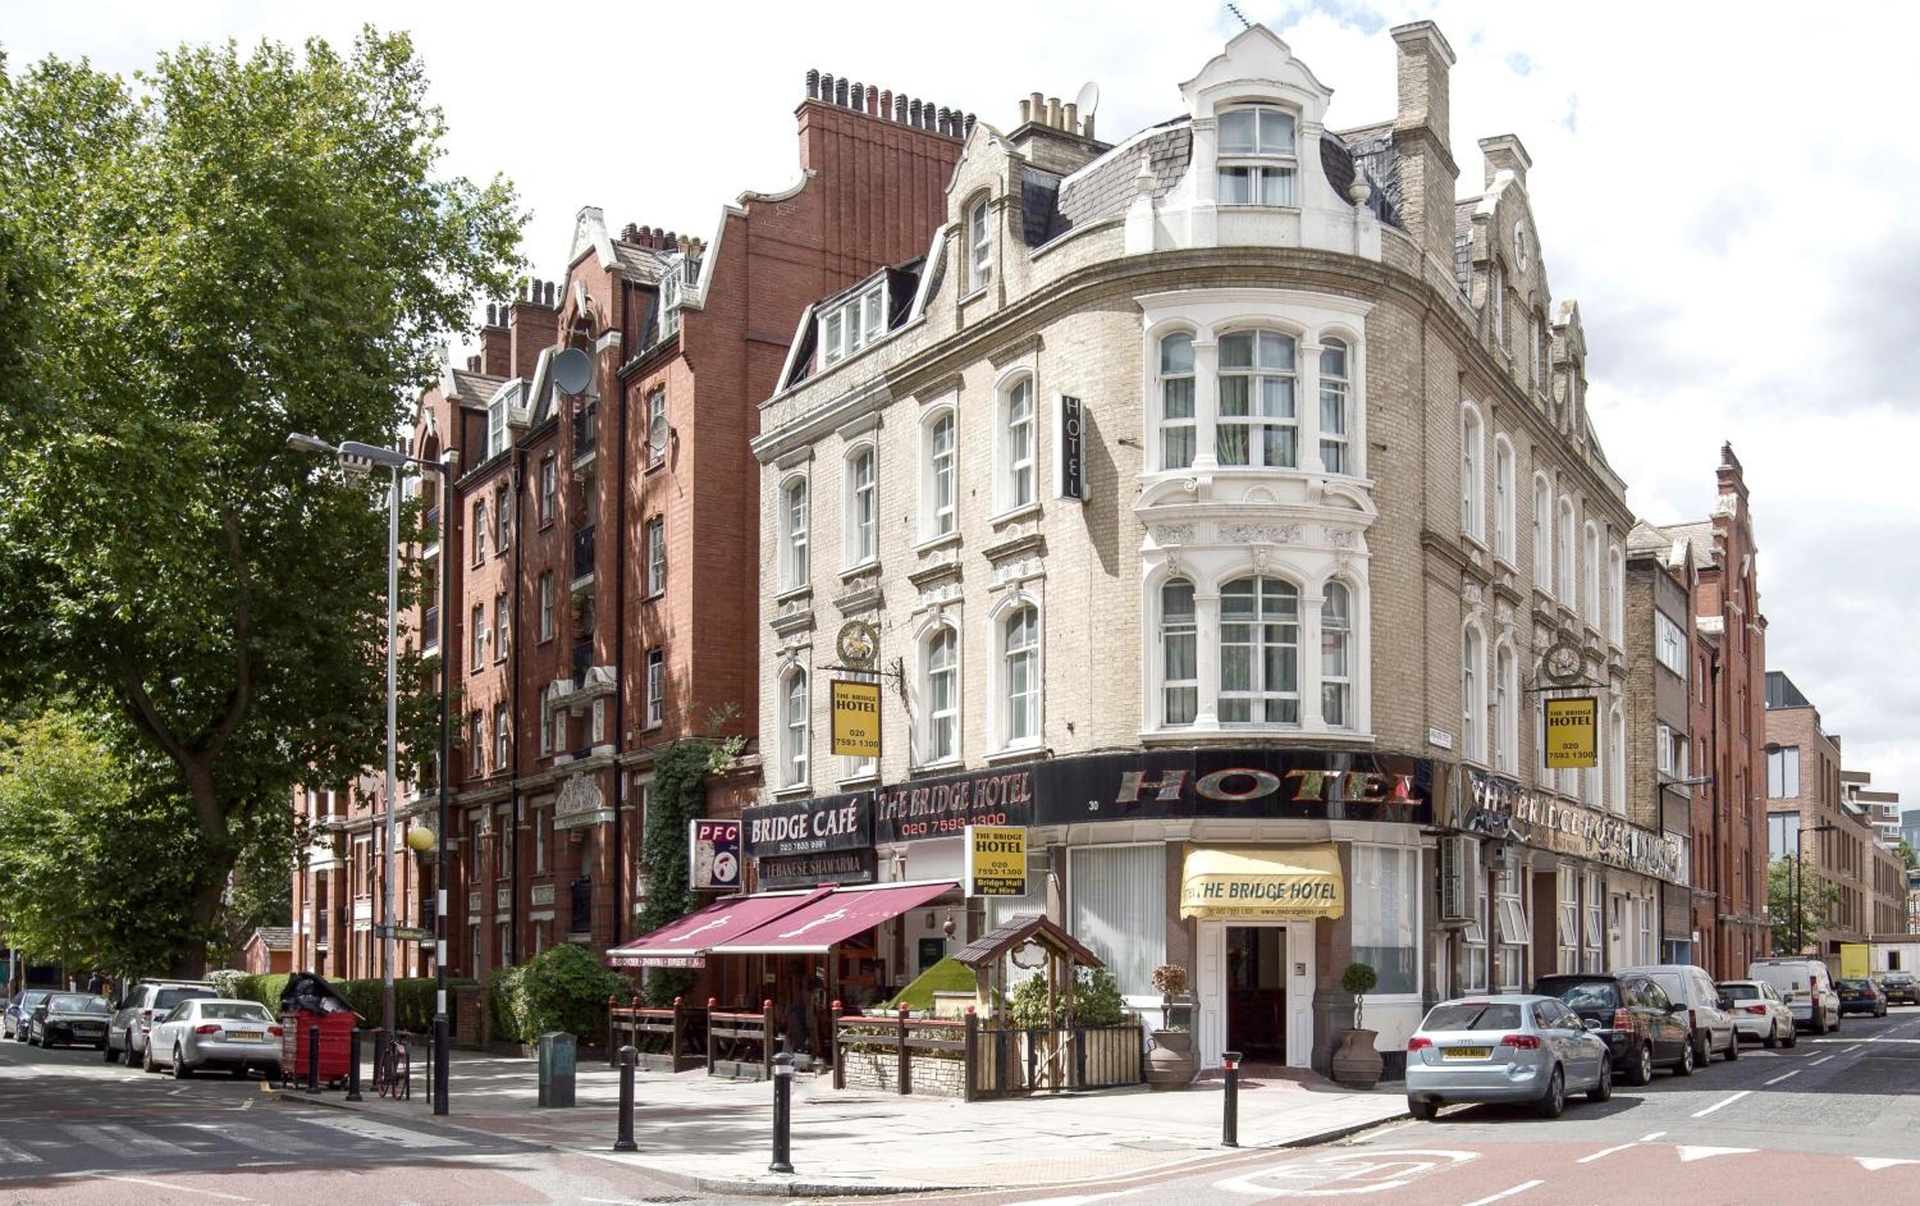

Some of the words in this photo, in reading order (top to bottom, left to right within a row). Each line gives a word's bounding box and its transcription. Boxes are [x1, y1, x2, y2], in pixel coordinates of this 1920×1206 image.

[1065, 397, 1080, 497] HOTEL
[836, 692, 849, 700] THE
[852, 694, 876, 702] BRIDGE
[836, 700, 877, 713] HOTEL
[1549, 716, 1593, 727] HOTEL
[849, 729, 865, 737] 020
[835, 738, 856, 746] 7593
[859, 740, 879, 748] 1300
[1572, 751, 1594, 759] 1300
[1116, 768, 1423, 805] HOTEL
[879, 789, 908, 821] THE
[909, 781, 970, 817] BRIDGE
[972, 772, 1032, 809] HOTEL
[1088, 800, 1099, 810] 30
[751, 813, 808, 843] BRIDGE
[813, 798, 858, 837] CAFÉ
[1516, 795, 1579, 836] BRIDGE
[902, 822, 927, 836] 020
[931, 817, 966, 833] 7593
[971, 813, 1006, 826] 1300
[699, 826, 738, 840] PFC
[975, 832, 990, 840] THE
[993, 833, 1023, 841] BRIDGE
[975, 841, 1023, 853] HOTEL
[766, 860, 808, 878] LEBANESE
[810, 856, 860, 876] SHAWARMA
[977, 879, 1004, 888] Bridge
[1006, 879, 1023, 887] Hall
[1229, 882, 1285, 901] BRIDGE
[1290, 882, 1337, 900] HOTEL
